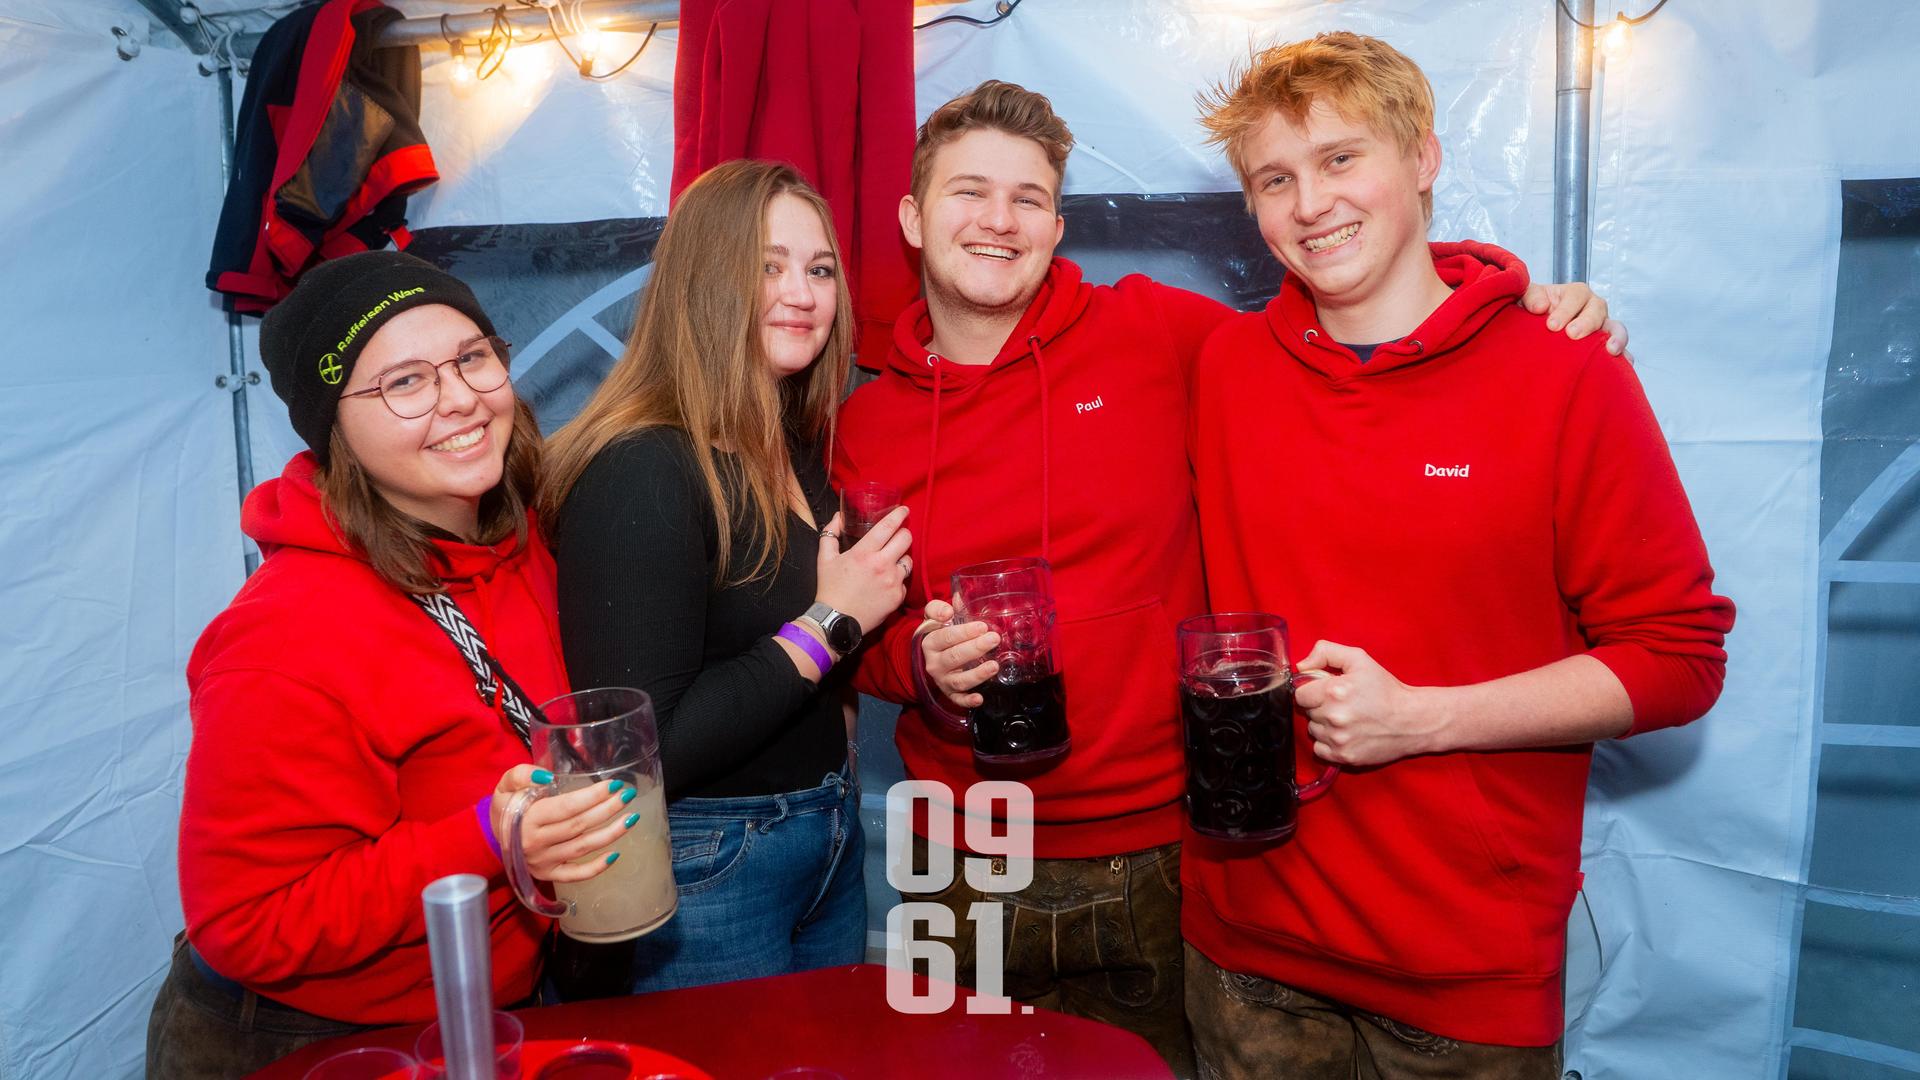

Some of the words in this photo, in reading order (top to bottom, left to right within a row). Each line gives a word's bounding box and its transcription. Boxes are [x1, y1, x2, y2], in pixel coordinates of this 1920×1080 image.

[337, 300, 391, 351] Raiffeisen
[1075, 395, 1104, 414] Paul
[1424, 463, 1470, 478] David
